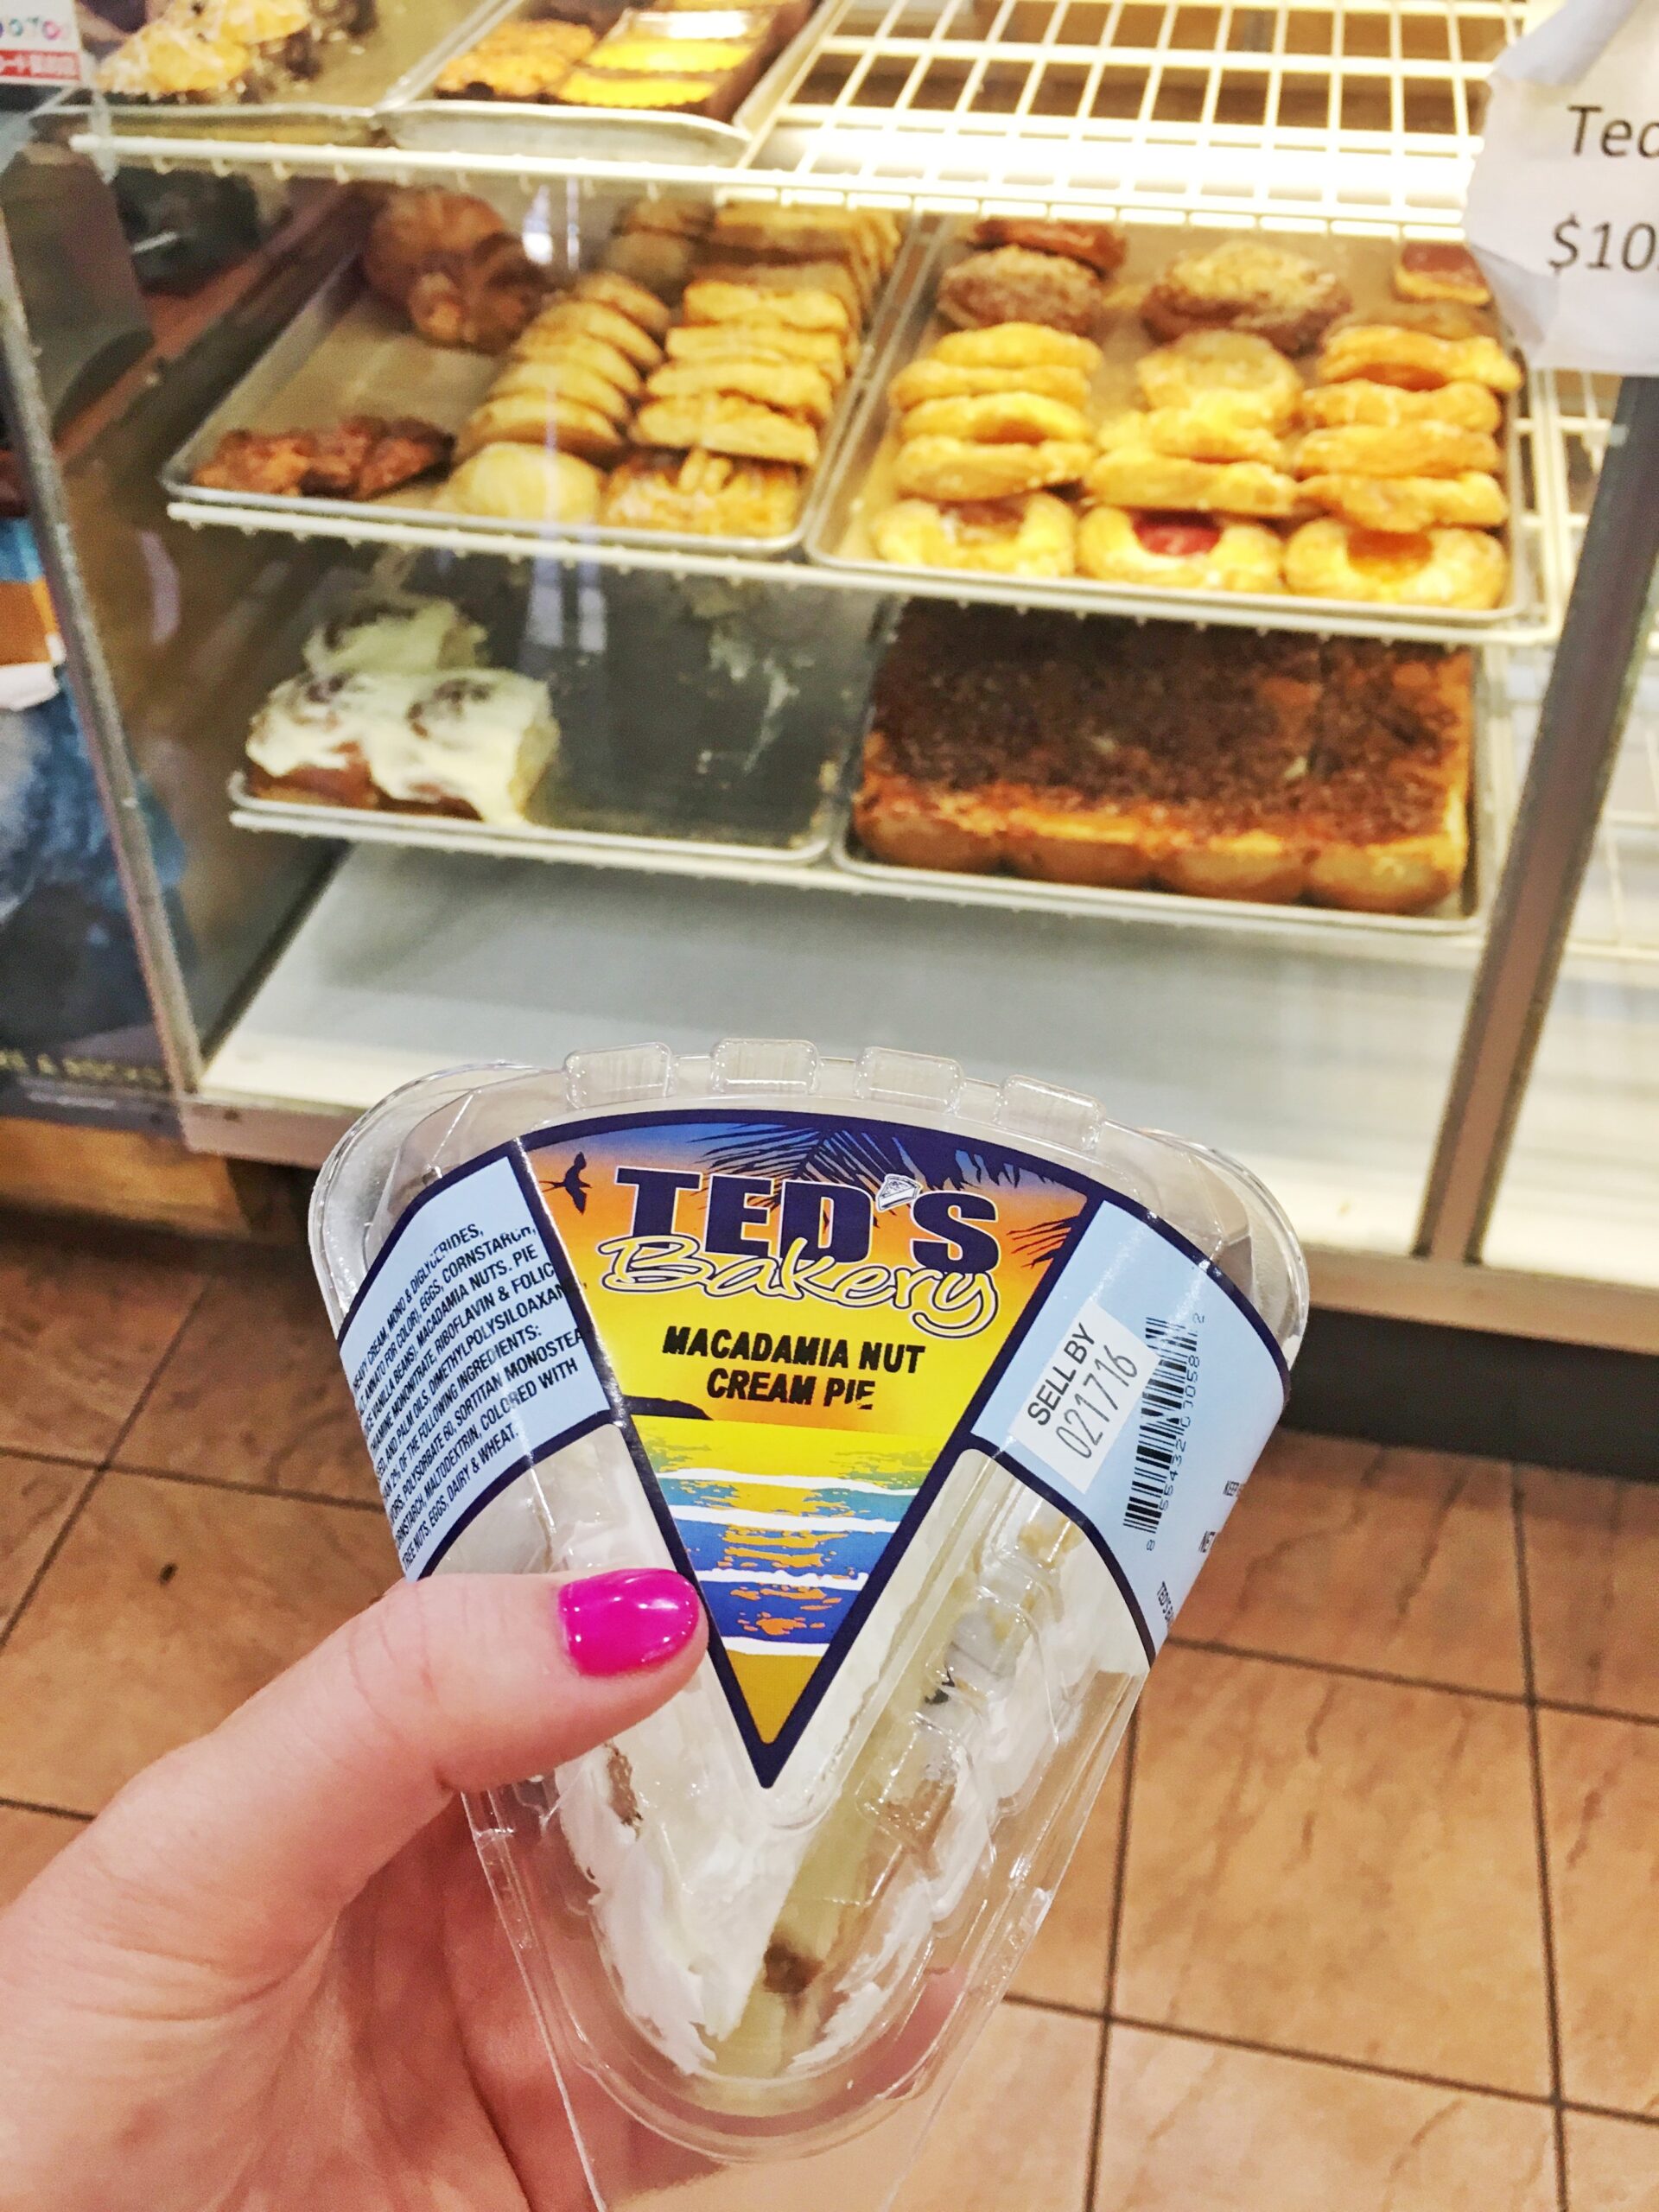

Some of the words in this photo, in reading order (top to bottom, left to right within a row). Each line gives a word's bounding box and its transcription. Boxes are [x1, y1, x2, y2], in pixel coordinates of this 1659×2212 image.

[372, 1377, 396, 1421] VANILLA
[416, 1283, 470, 1350] MACADAMIA
[468, 1260, 512, 1291] NUTS.
[512, 1243, 538, 1268] PIE
[385, 1341, 398, 1368] FOR
[420, 1279, 444, 1313] EGGS,
[435, 1292, 495, 1356] RIBOFLAVIN
[498, 1286, 511, 1302] &
[511, 1262, 554, 1294] FOLIC
[598, 1235, 999, 1339] Bakery
[399, 1452, 408, 1472] OF
[406, 1434, 420, 1460] THE
[418, 1383, 459, 1443] FOLLOWING
[456, 1325, 542, 1392] INGREDIENTS:
[662, 1325, 849, 1370] MACADAMIA
[861, 1343, 925, 1374] NUT
[707, 1367, 817, 1406] CREAM
[824, 1378, 876, 1410] PIE
[1027, 1365, 1077, 1426] SELL
[1064, 1322, 1095, 1364] BY
[1056, 1344, 1138, 1459] 021716
[385, 1437, 398, 1464] AND
[397, 1410, 415, 1445] PALM
[403, 1433, 444, 1501] POLYSORBATE
[454, 1372, 503, 1427] SORTITAN
[424, 1424, 482, 1501] MALTODEXTRIN,
[480, 1380, 537, 1431] COLORED
[537, 1357, 579, 1389] WITH
[428, 1495, 449, 1528] EGGS,
[447, 1464, 471, 1502] DAIRY
[471, 1457, 480, 1473] &
[478, 1422, 518, 1465] WHEAT.
